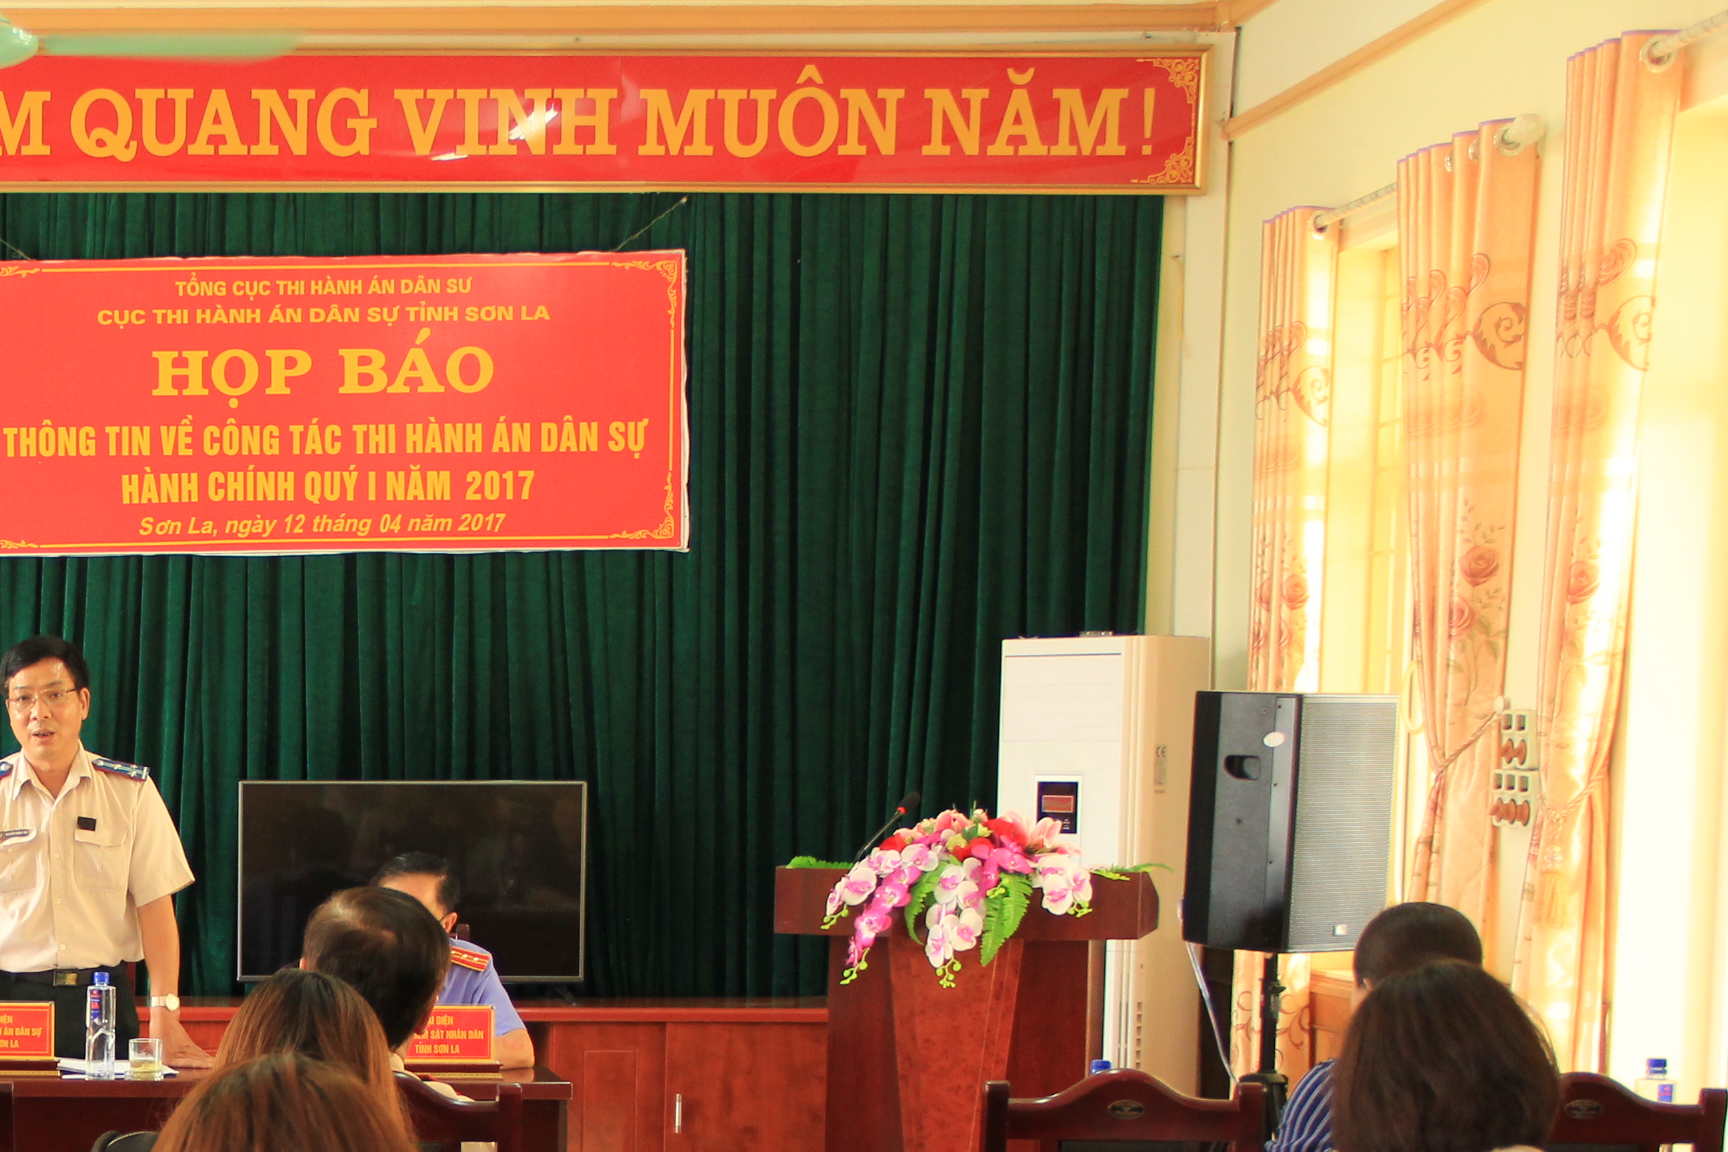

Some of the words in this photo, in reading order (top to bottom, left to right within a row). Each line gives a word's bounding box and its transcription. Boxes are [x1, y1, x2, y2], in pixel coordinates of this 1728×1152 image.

[70, 87, 378, 163] QUANG
[394, 88, 618, 158] VINH
[639, 64, 899, 159] MUÔN
[175, 272, 227, 297] TỔNG
[232, 280, 271, 301] CỤC
[276, 280, 305, 296] THI
[310, 275, 363, 296] HÀNH
[368, 275, 395, 295] ÁN
[401, 275, 441, 295] DÂN
[97, 309, 146, 330] CỤC
[152, 309, 189, 325] THI
[196, 304, 261, 324] HÀNH
[268, 304, 302, 324] ÁN
[309, 303, 360, 323] DÂN
[367, 305, 401, 327] SỰ
[405, 300, 459, 322] TỈNH
[464, 305, 514, 322] SƠN
[521, 305, 551, 321] LA
[151, 348, 313, 409] HỌP
[338, 327, 495, 394] BÁO
[2, 419, 97, 458] THÔNG
[104, 425, 151, 456] TIN
[160, 414, 194, 456] VỀ
[203, 417, 280, 456] CÔNG
[288, 417, 342, 455] TÁC
[352, 423, 396, 455] THI
[405, 416, 483, 454] HÀNH
[491, 415, 531, 453] ÁN
[540, 414, 599, 453] DÂN
[607, 417, 649, 459] SỰ
[121, 466, 199, 505] HÀNH
[207, 464, 295, 502] CHÍNH
[304, 464, 359, 505] QUÝ
[368, 470, 377, 501] I
[386, 464, 451, 501] NĂM
[465, 470, 535, 501] 2017
[138, 516, 183, 536] Sơn
[187, 516, 218, 537] La,
[224, 514, 277, 538] ngày
[283, 514, 306, 534] 12
[312, 514, 373, 537] tháng
[378, 513, 401, 534] 04
[407, 514, 453, 533] năm
[457, 513, 506, 533] 2017
[3, 1025, 14, 1036] ÁN
[15, 1025, 30, 1036] DÂN
[31, 1026, 43, 1038] SỰ
[430, 1028, 445, 1039] SÁT
[445, 1028, 467, 1039] NHÂN
[468, 1028, 484, 1039] DÂN
[435, 1013, 454, 1027] DIỆN
[10, 1039, 19, 1048] LA
[451, 1044, 460, 1054] LA
